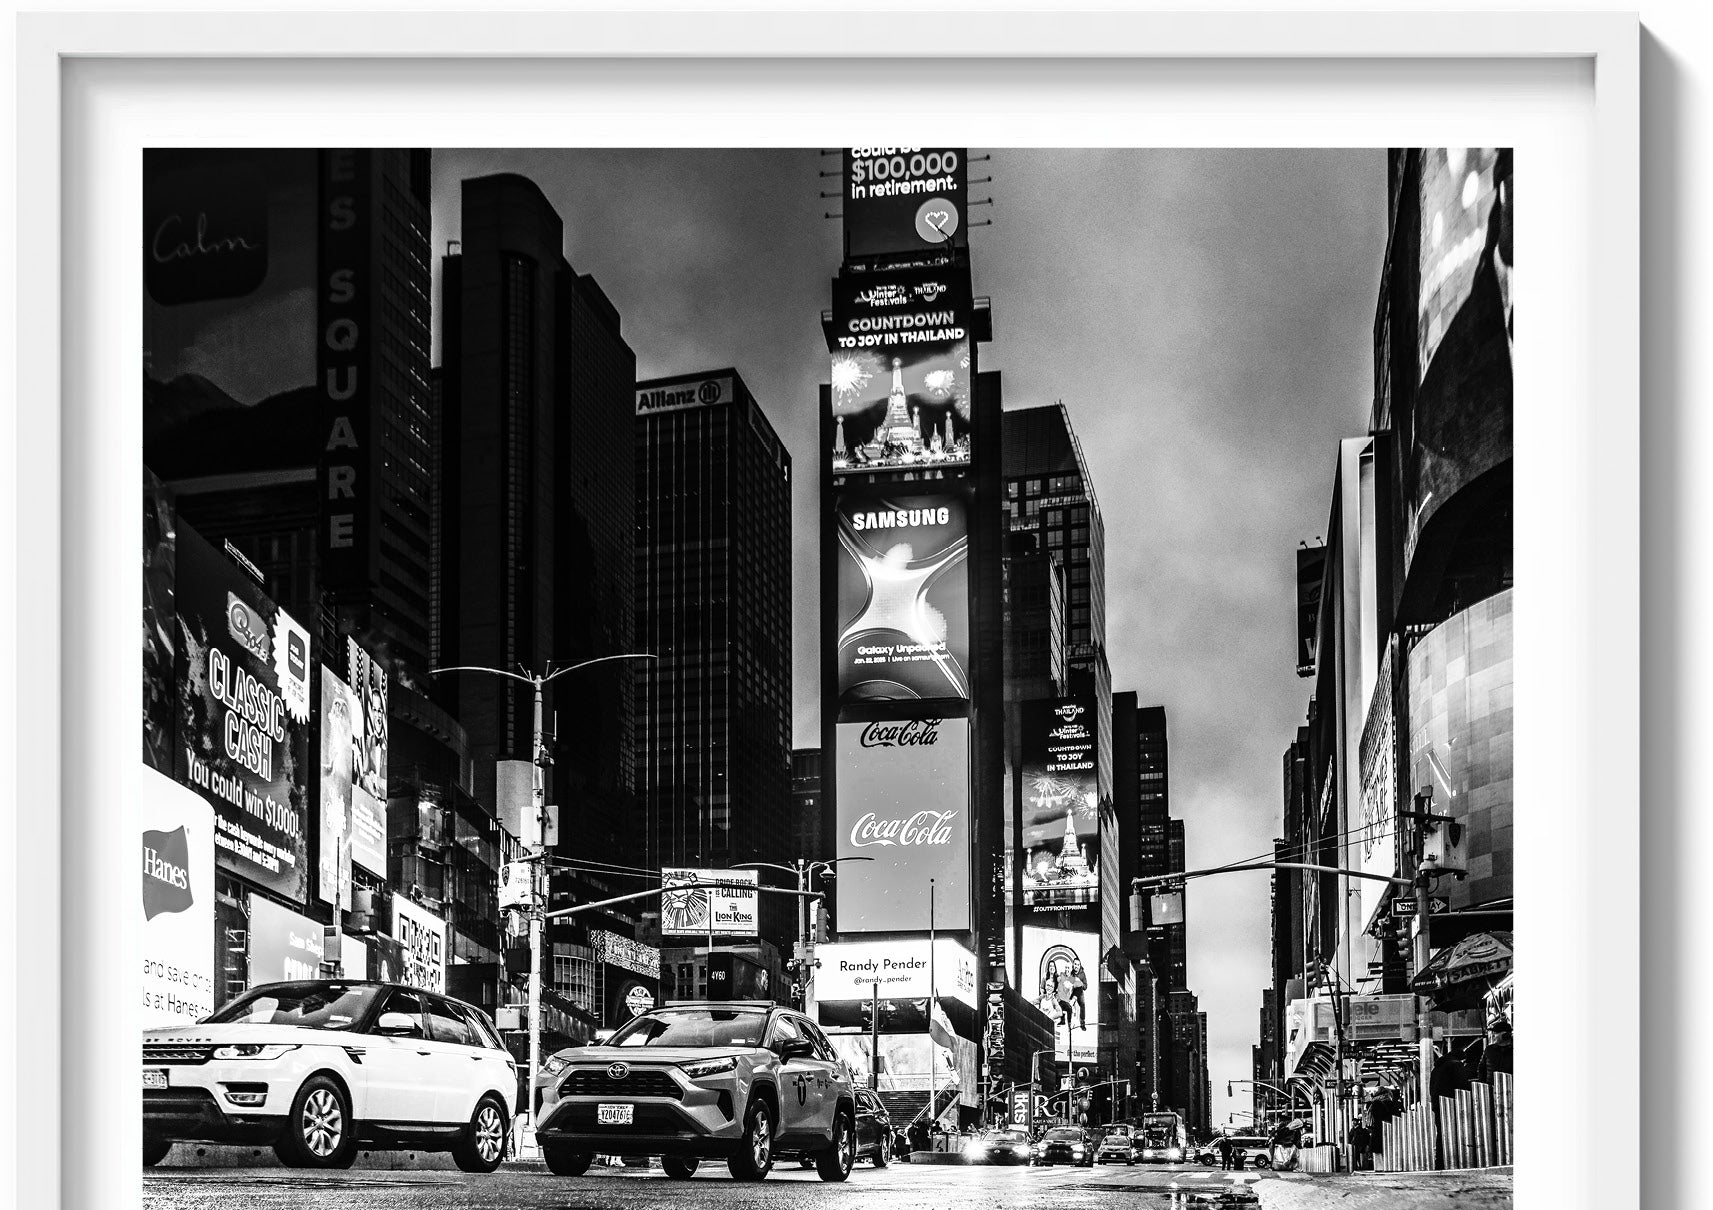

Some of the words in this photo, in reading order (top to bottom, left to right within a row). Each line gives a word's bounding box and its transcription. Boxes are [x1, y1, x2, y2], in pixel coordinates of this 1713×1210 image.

[852, 151, 957, 184] $100,000
[852, 182, 866, 199] in
[869, 174, 957, 198] retirement.
[153, 211, 260, 263] Calm
[848, 311, 954, 333] COUNTDOWN
[838, 336, 856, 348] TO
[858, 334, 883, 347] JOY
[885, 332, 898, 345] IN
[900, 327, 965, 344] THAILAND
[326, 268, 359, 549] SQUARE
[638, 389, 696, 411] Allianz
[852, 507, 949, 531] SAMSUNG
[857, 646, 894, 656] Galaxy
[896, 642, 946, 655] Unpad
[209, 648, 285, 742] CLASSIC
[860, 718, 942, 748] Coca-Cola
[225, 711, 272, 782] CASH
[1048, 744, 1092, 752] COUNTDOWN
[1056, 761, 1094, 771] THAILAND
[186, 747, 210, 789] You
[211, 770, 243, 809] could
[244, 788, 264, 820] win
[265, 794, 299, 840] $1,000!
[850, 809, 960, 847] Coca-Cola
[144, 847, 188, 890] Hanes
[721, 888, 753, 898] CALLING
[715, 911, 732, 922] LION
[733, 912, 752, 922] KING
[143, 959, 164, 978] and
[167, 966, 189, 985] save
[840, 958, 879, 973] Randy
[883, 956, 927, 969] Pender
[854, 975, 912, 985] @randy_pender
[154, 993, 164, 1010] at
[167, 993, 213, 1018] Hanes
[1354, 1002, 1380, 1016] ele
[1014, 1092, 1028, 1123] tkts
